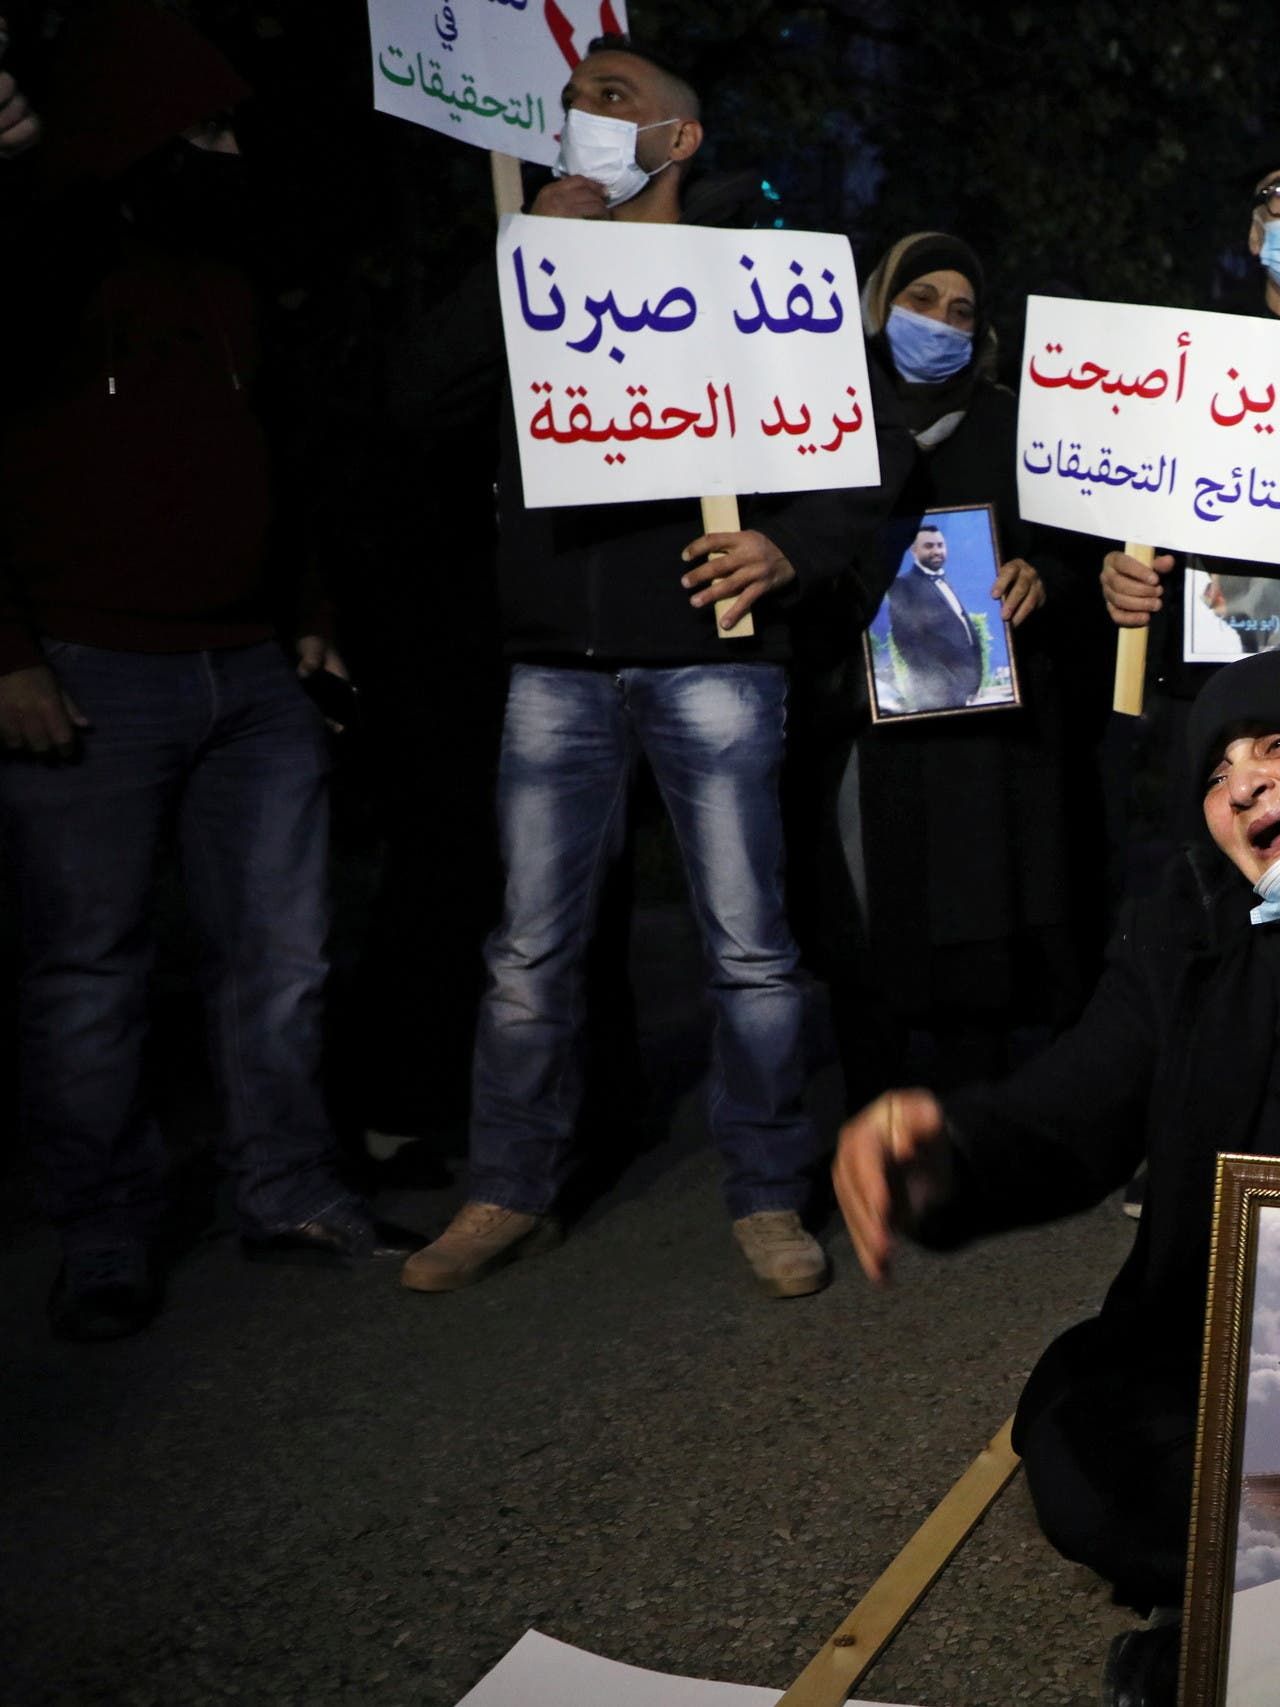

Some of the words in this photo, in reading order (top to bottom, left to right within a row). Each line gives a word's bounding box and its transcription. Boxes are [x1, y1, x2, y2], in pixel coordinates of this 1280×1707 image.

[379, 45, 546, 134] التحقيقات
[512, 246, 697, 364] صبرنا
[733, 254, 844, 334] نفذ
[1029, 331, 1192, 415] أصبحت
[529, 381, 736, 466] الحقيقة
[760, 385, 863, 456] نريد
[1023, 439, 1177, 496] التحقيقات
